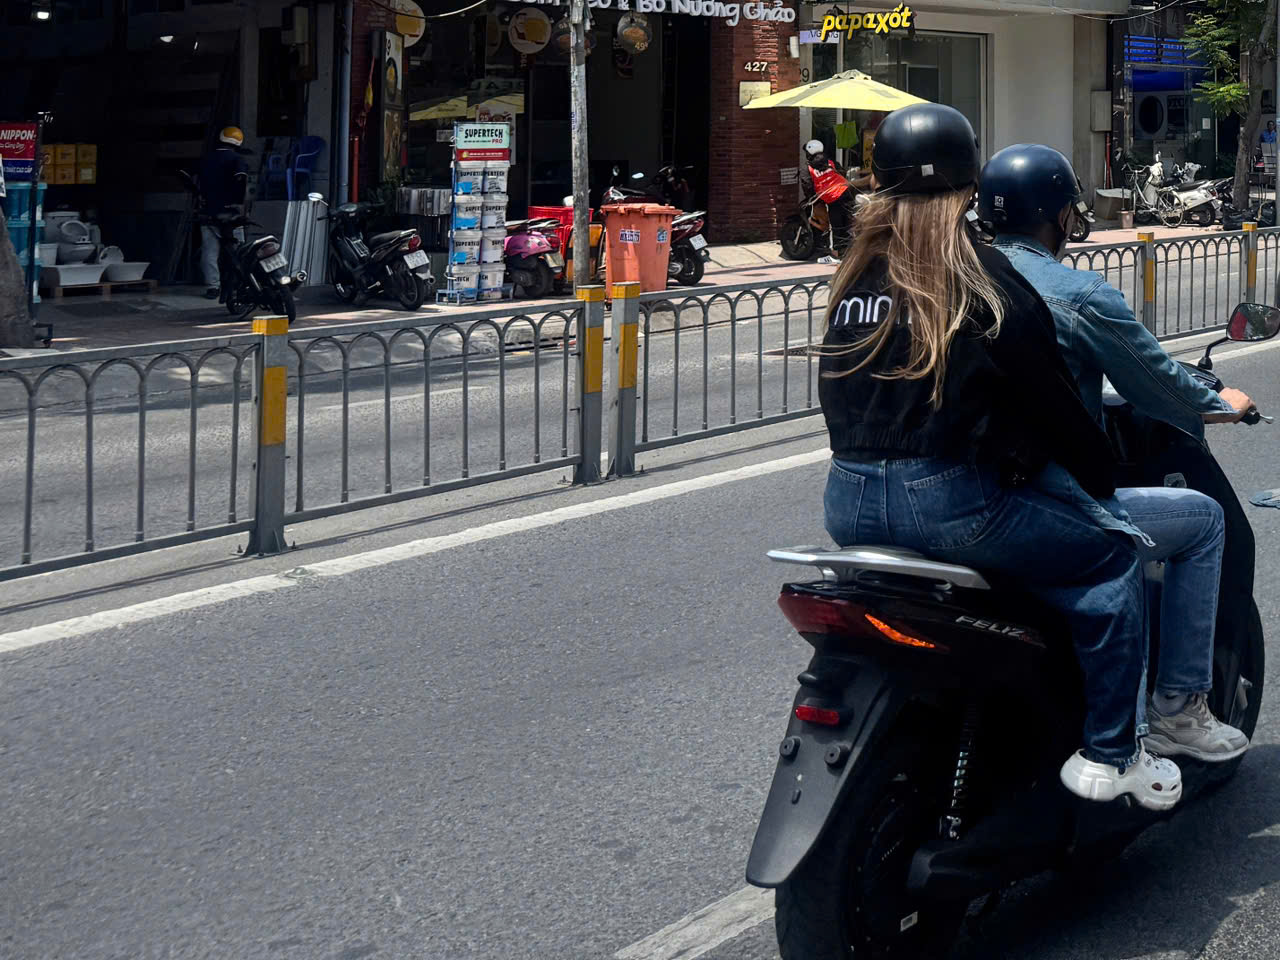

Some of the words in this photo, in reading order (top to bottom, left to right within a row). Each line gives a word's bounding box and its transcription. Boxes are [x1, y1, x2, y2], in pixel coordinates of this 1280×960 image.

[743, 0, 796, 23] Chảo
[821, 1, 913, 41] papaxốt
[744, 61, 768, 72] 427
[464, 128, 504, 139] SUPERTECH
